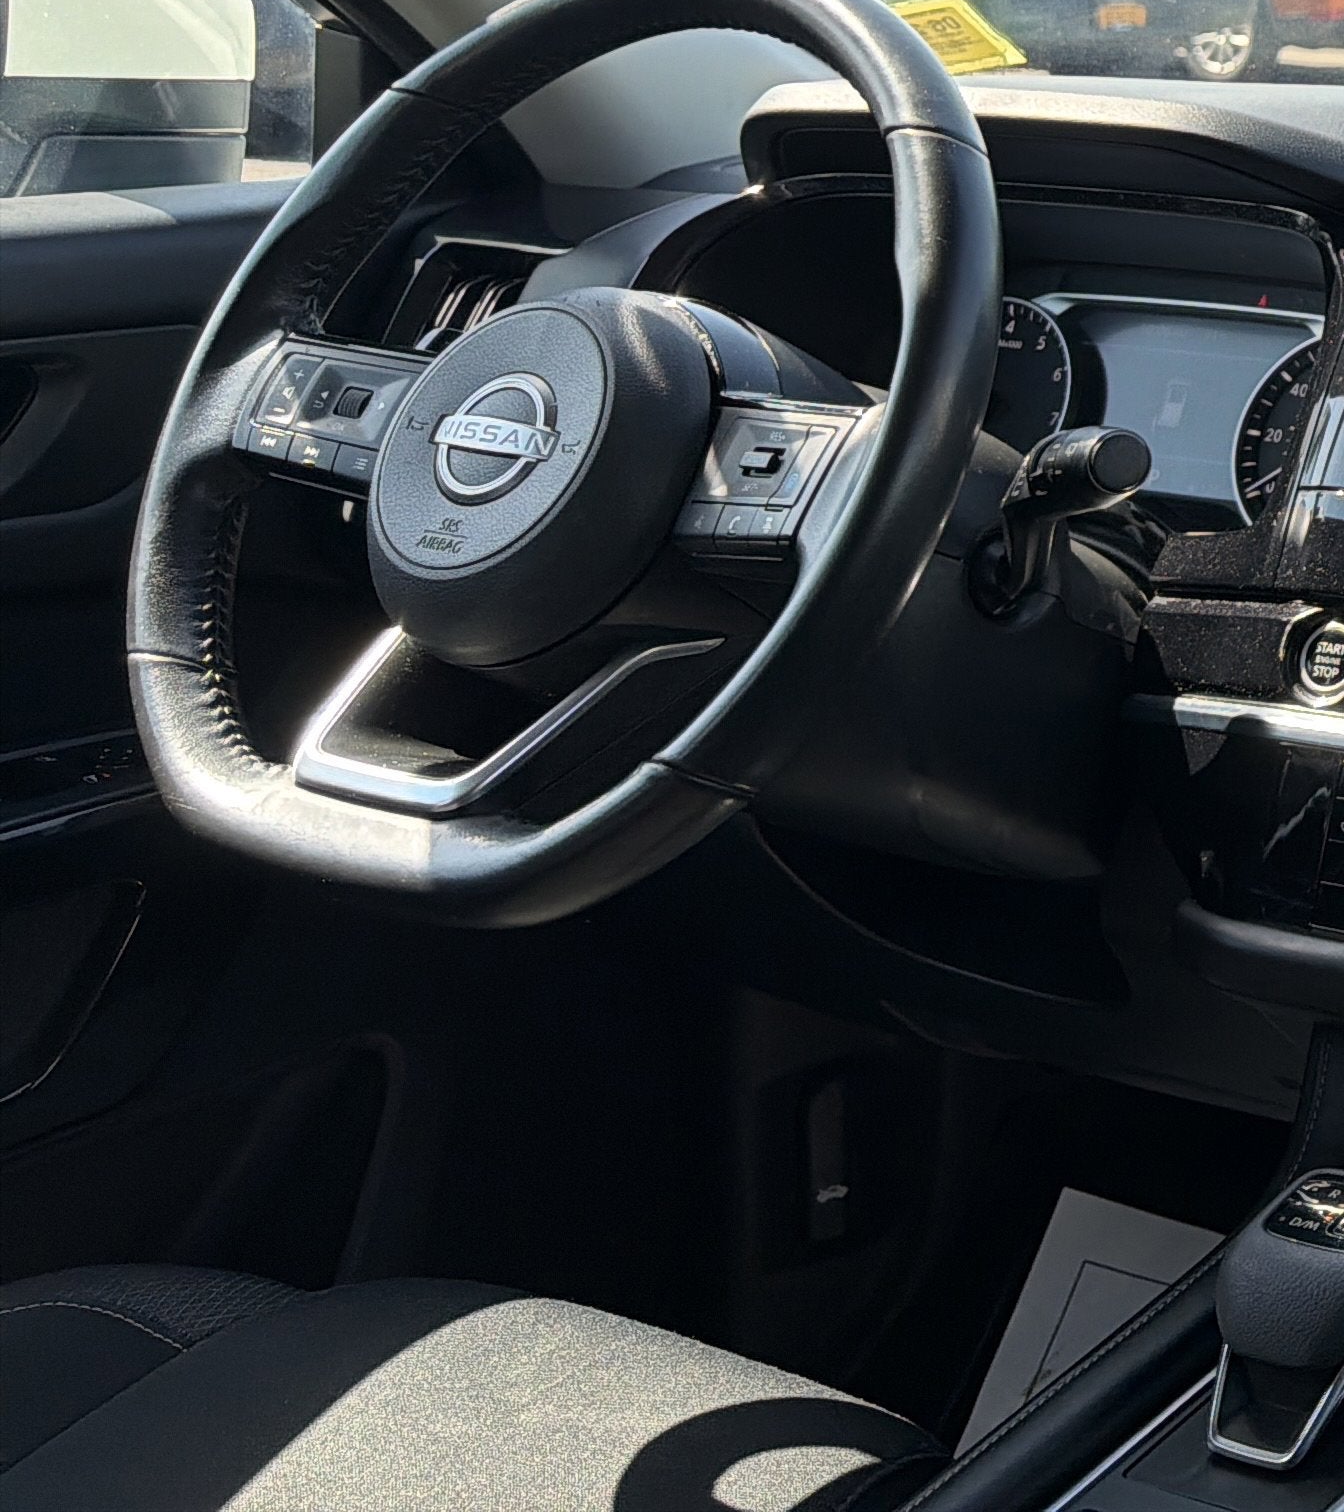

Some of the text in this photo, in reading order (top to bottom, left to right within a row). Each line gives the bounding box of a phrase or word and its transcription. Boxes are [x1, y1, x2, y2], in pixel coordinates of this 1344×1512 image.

[1005, 320, 1015, 334] 4
[1035, 336, 1047, 351] 5
[1053, 368, 1062, 382] 6
[1290, 383, 1309, 398] 40
[1050, 412, 1060, 426] 7
[444, 420, 553, 457] NISSAN
[1264, 428, 1283, 443] 20
[438, 517, 464, 533] SRS
[416, 534, 465, 554] AIRBAG
[1312, 665, 1340, 678] STOP
[1328, 1189, 1342, 1199] R
[1289, 1216, 1320, 1232] D/M
